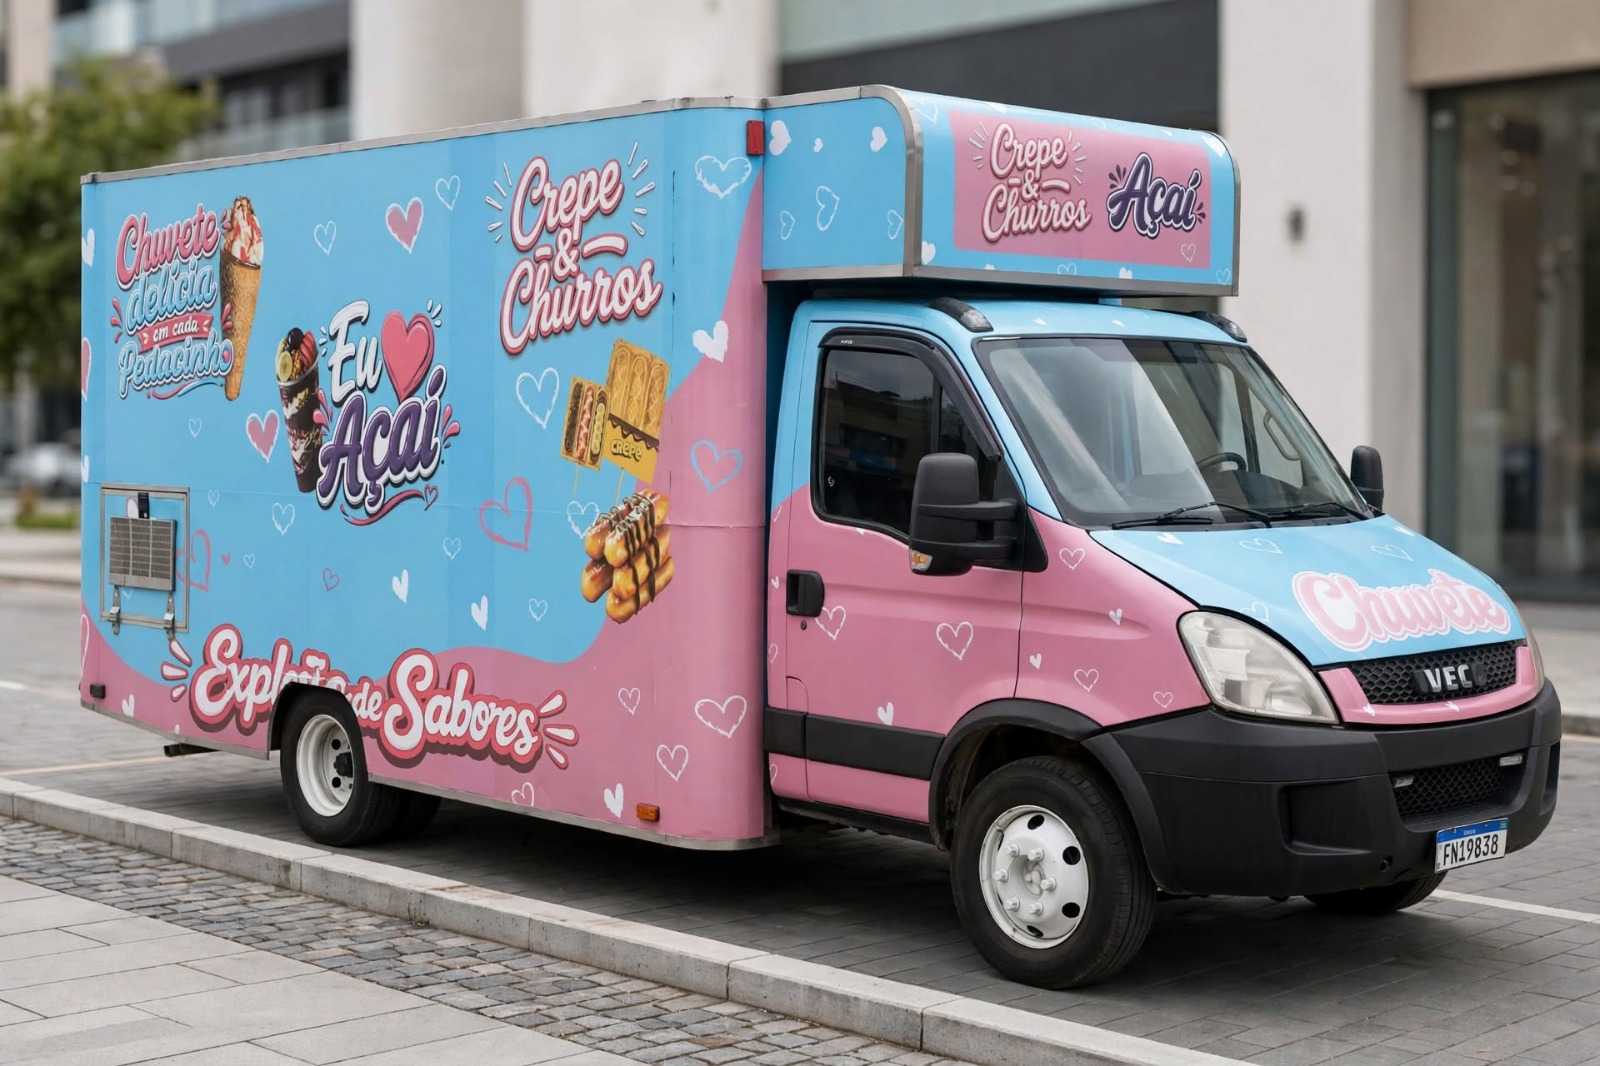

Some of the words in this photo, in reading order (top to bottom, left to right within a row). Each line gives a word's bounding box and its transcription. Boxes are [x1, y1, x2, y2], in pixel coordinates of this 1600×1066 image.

[990, 123, 1068, 178] Crepe
[1021, 169, 1040, 200] &
[510, 156, 625, 251] Crepe
[982, 184, 1092, 243] Churros
[1106, 152, 1202, 239] Açaí
[116, 203, 221, 290] Chuvete
[553, 227, 579, 281] &
[172, 316, 199, 336] cada
[500, 257, 664, 354] Churros
[119, 328, 234, 399] Pedacinho
[327, 300, 383, 405] Eu
[1292, 568, 1512, 652] Chuvete
[352, 681, 384, 722] de
[381, 650, 541, 758] Sabores
